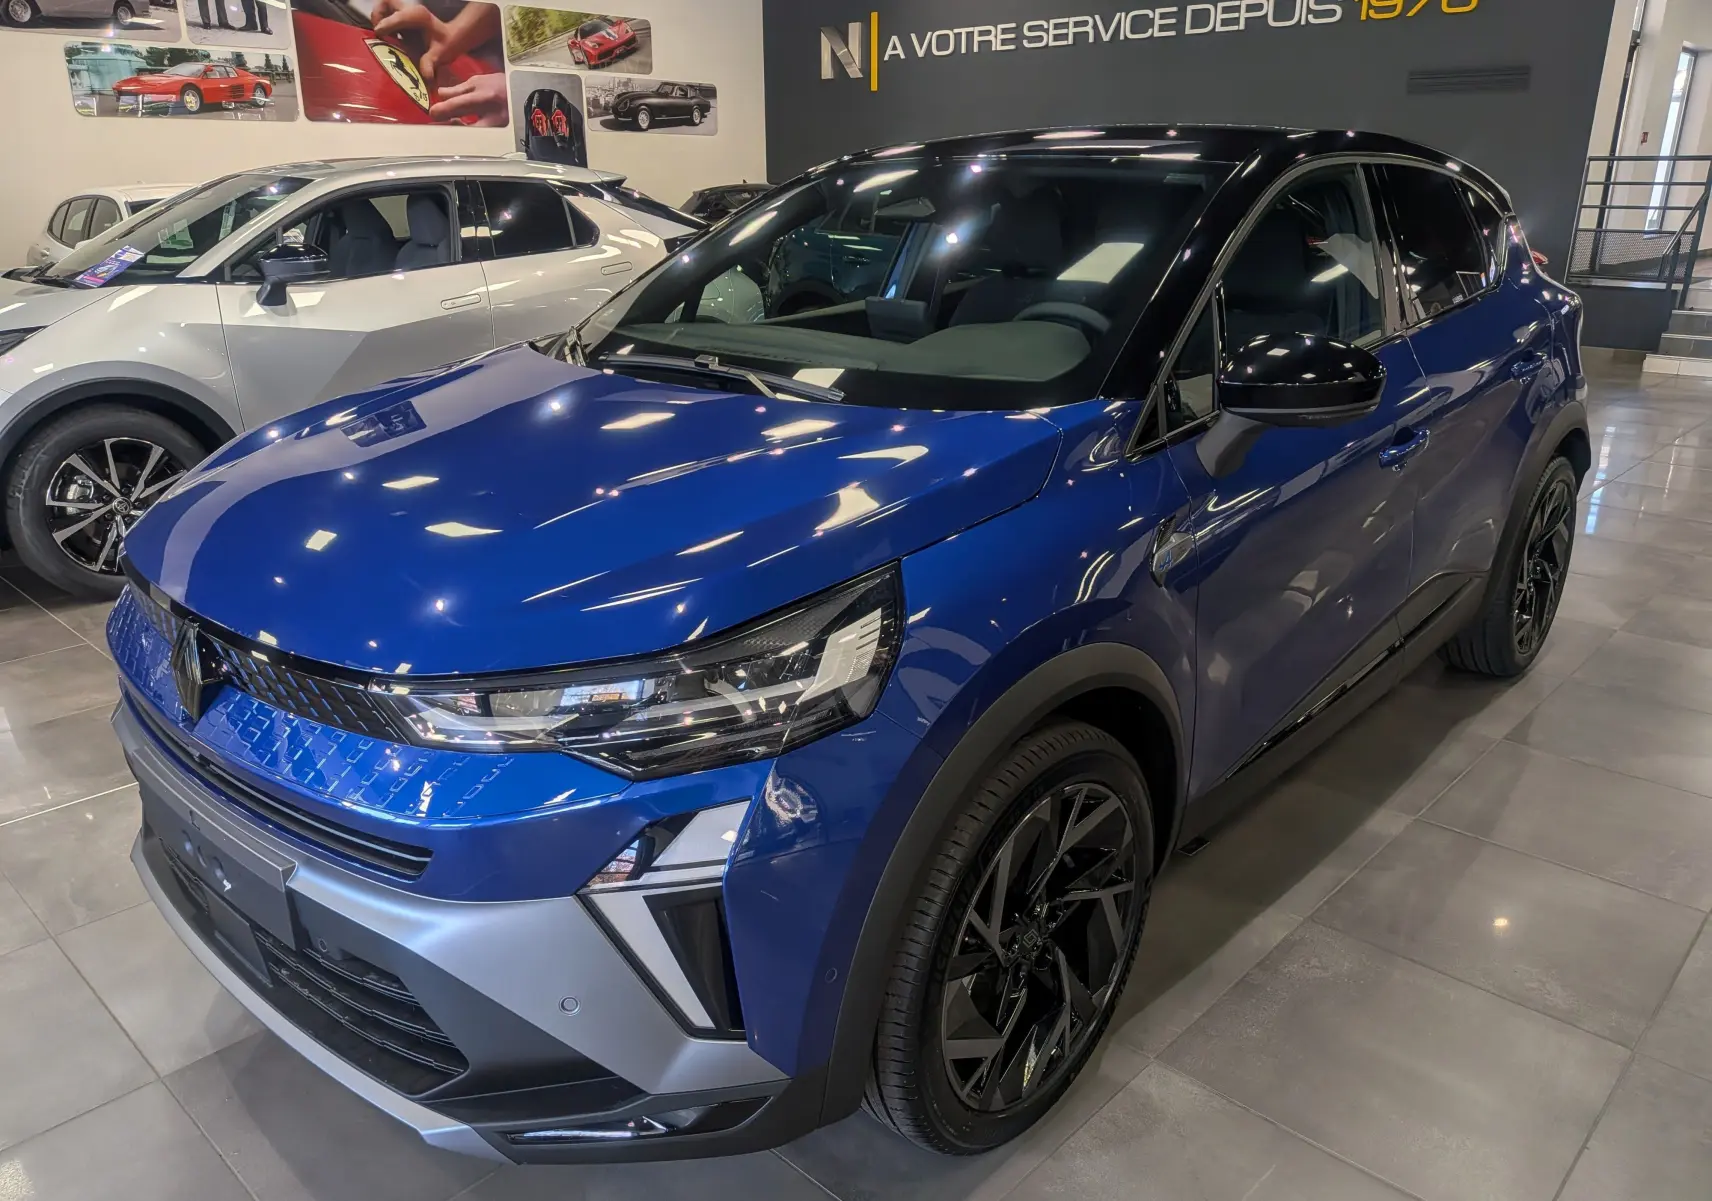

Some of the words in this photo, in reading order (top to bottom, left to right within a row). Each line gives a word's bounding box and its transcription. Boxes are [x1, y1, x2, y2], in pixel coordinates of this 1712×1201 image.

[884, 35, 906, 61] A
[910, 22, 1017, 58] VOTRE
[1022, 6, 1179, 48] SERVICE
[1185, 0, 1343, 35] DEPUIS
